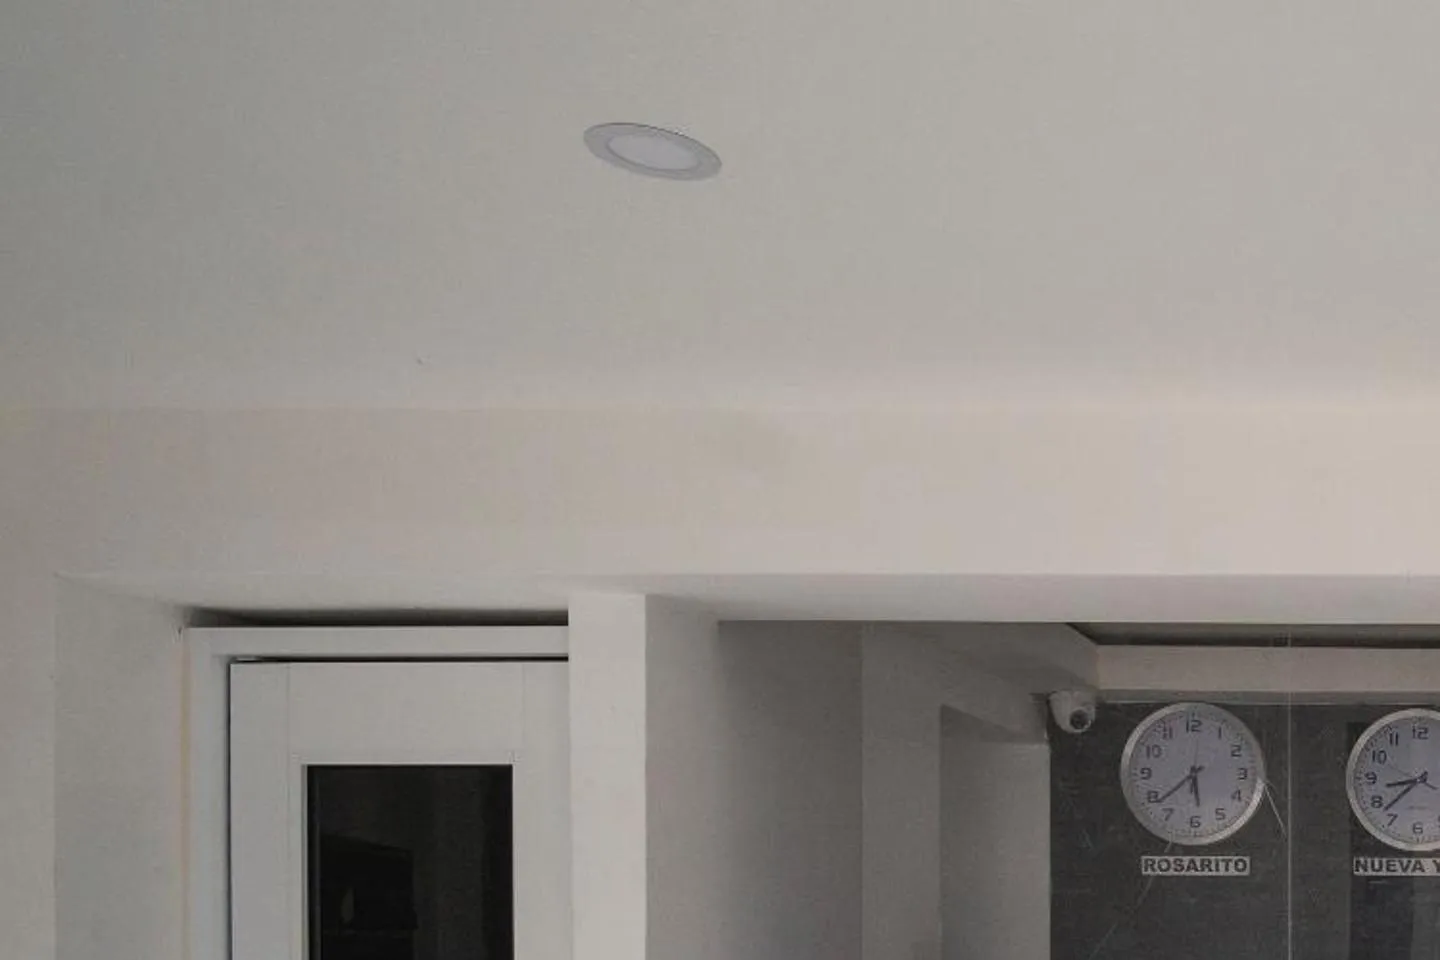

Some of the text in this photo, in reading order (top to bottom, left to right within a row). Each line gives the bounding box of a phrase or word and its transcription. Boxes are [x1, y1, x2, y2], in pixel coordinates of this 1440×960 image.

[1186, 719, 1203, 733] 12
[1412, 726, 1428, 739] 12
[1389, 732, 1399, 746] 11
[1146, 744, 1162, 759] 10
[1231, 745, 1242, 757] 2
[1372, 750, 1387, 764] 10
[1140, 767, 1152, 780] 9
[1238, 768, 1248, 780] 3
[1365, 772, 1377, 785] 9
[1147, 791, 1160, 803] 8
[1231, 790, 1241, 801] 4
[1371, 796, 1382, 808] 8
[1162, 808, 1174, 821] 7
[1215, 808, 1226, 820] 5
[1387, 813, 1398, 826] 7
[1190, 816, 1200, 828] 6
[1413, 822, 1423, 834] 6
[1142, 858, 1248, 874] ROSARITO
[1355, 858, 1424, 874] NUEVA
